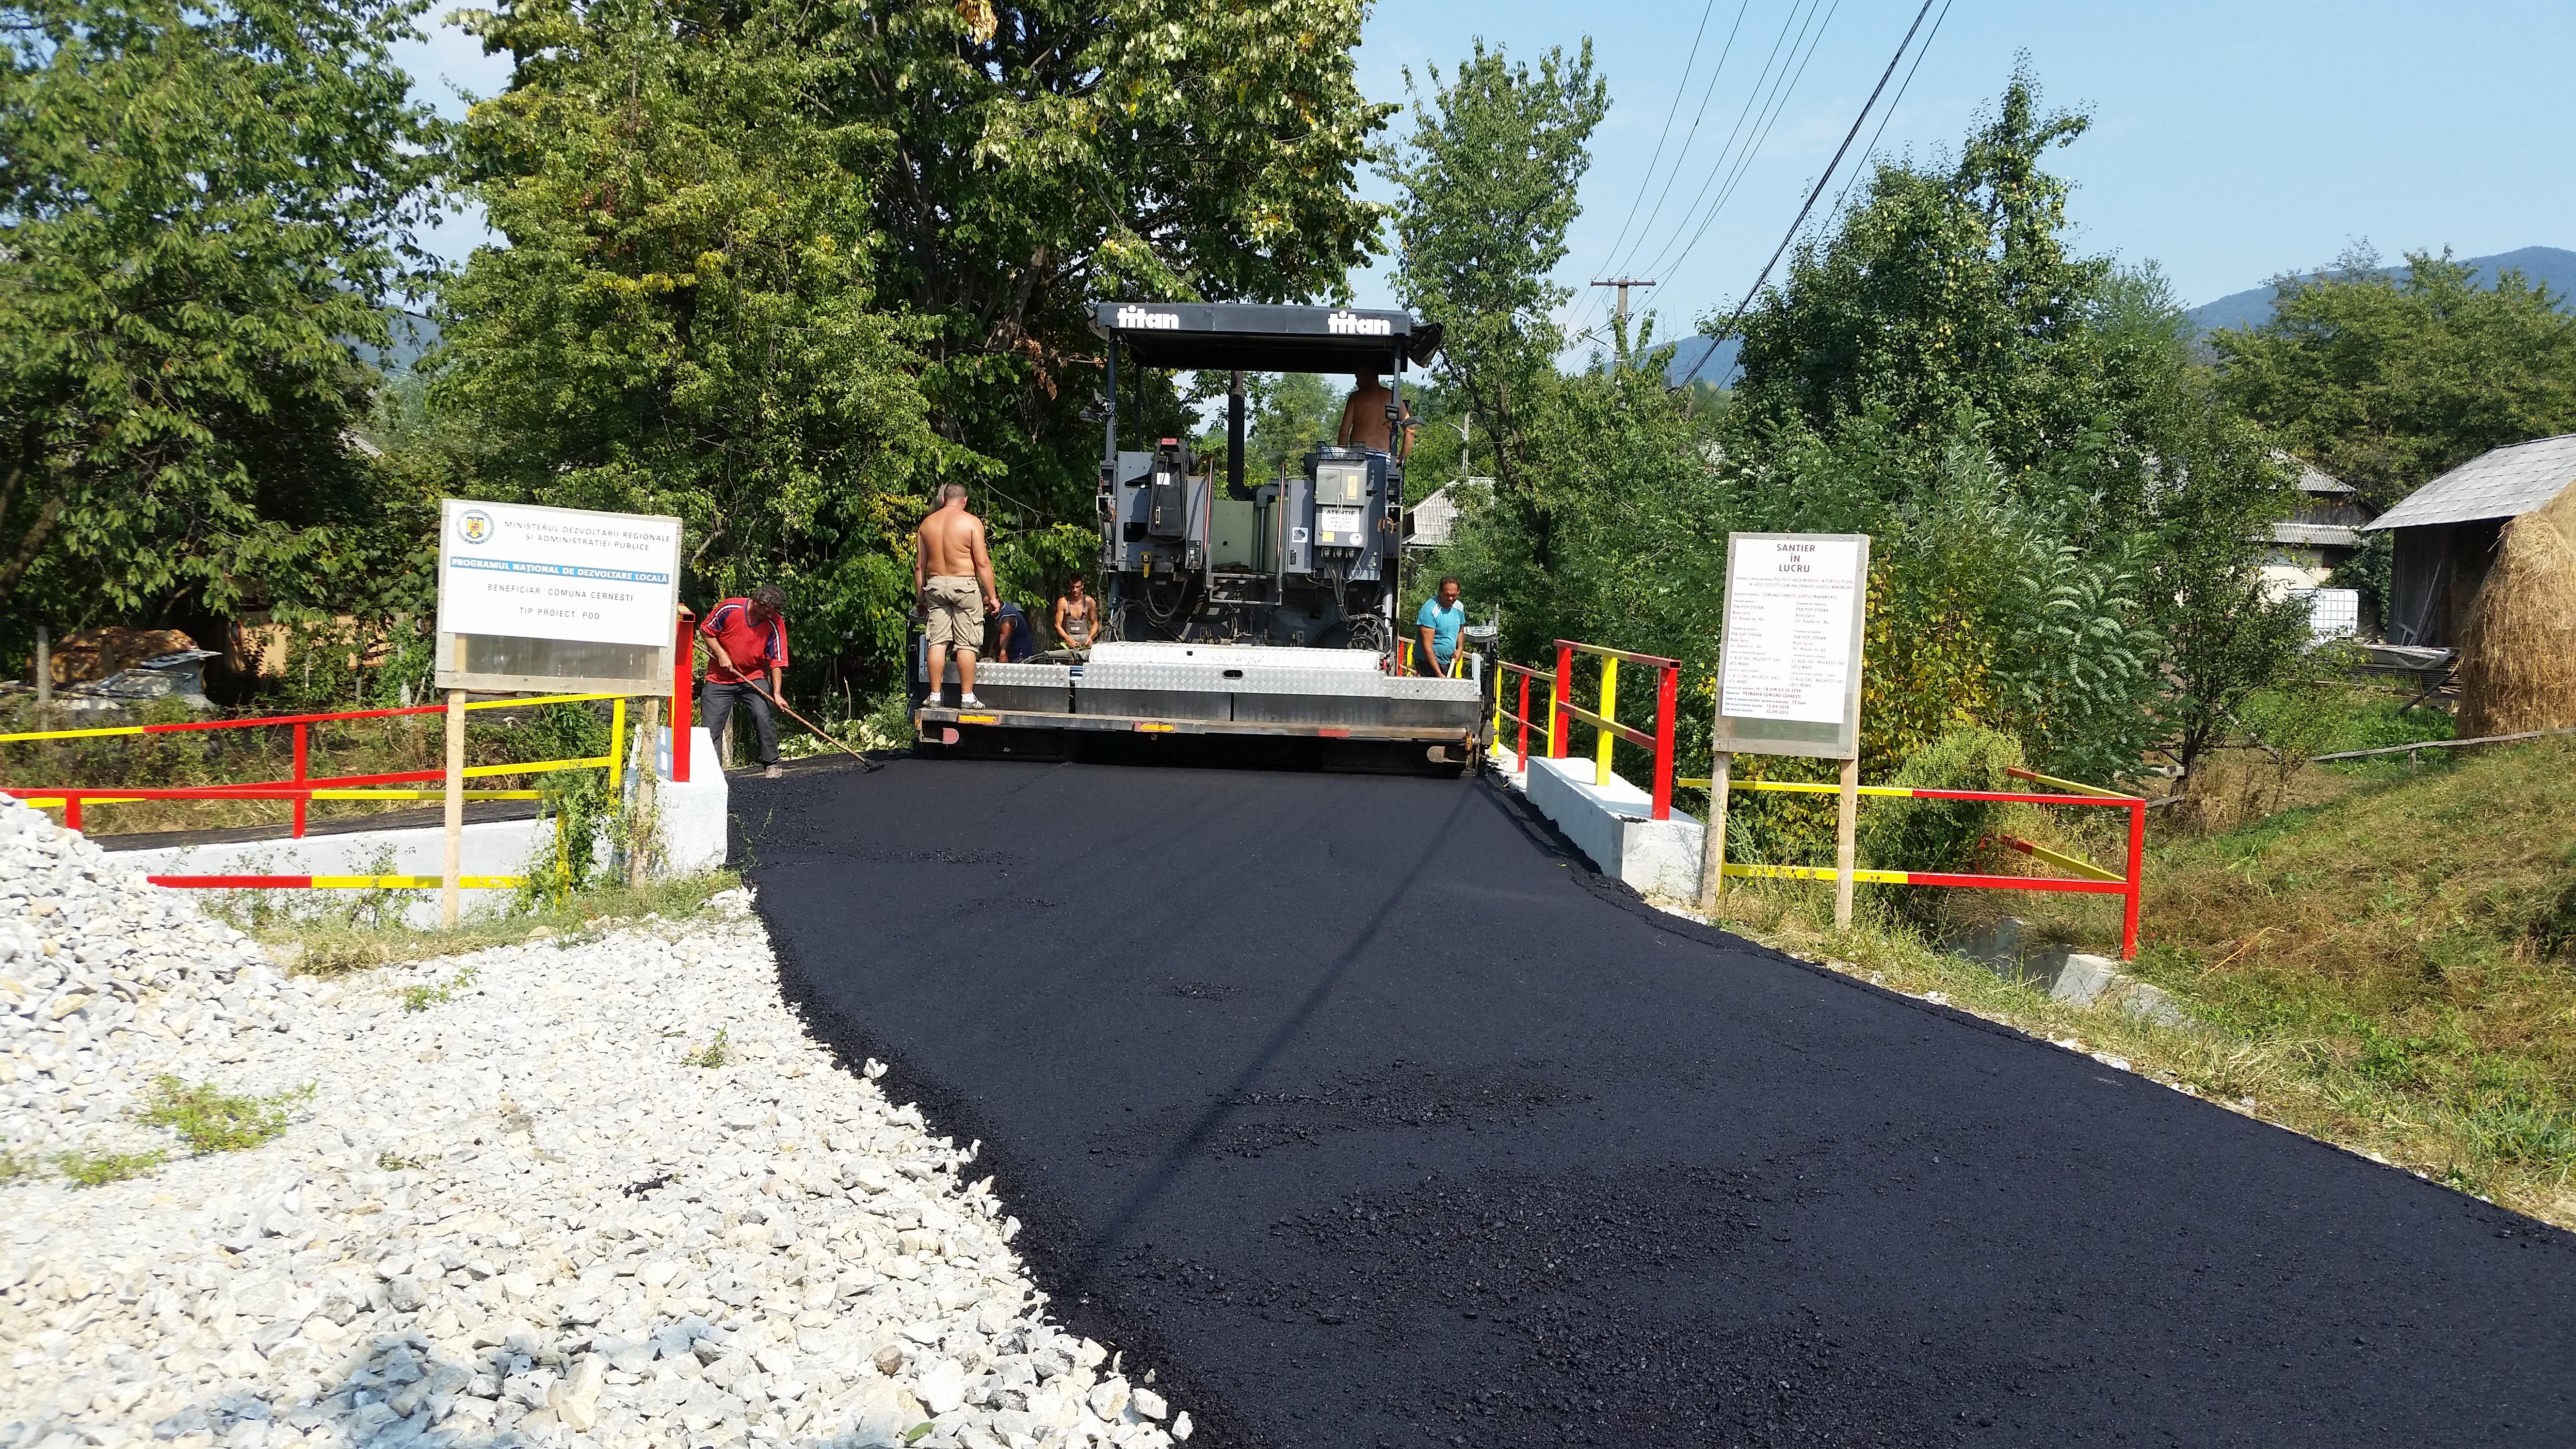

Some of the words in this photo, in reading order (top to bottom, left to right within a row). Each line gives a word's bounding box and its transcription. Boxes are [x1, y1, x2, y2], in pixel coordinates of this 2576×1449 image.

[1117, 305, 1179, 329] titan
[1328, 310, 1390, 334] titan
[505, 521, 558, 531] MINISTERUL
[563, 527, 619, 537] DEZVOLTARII
[623, 532, 670, 542] REGIONALE
[614, 542, 649, 550] PUBLICE
[452, 558, 510, 570] PROGRAMUL
[578, 568, 632, 580] DEZVOLTARE
[1779, 564, 1810, 572] LUCRU
[548, 588, 586, 597] COMUNA
